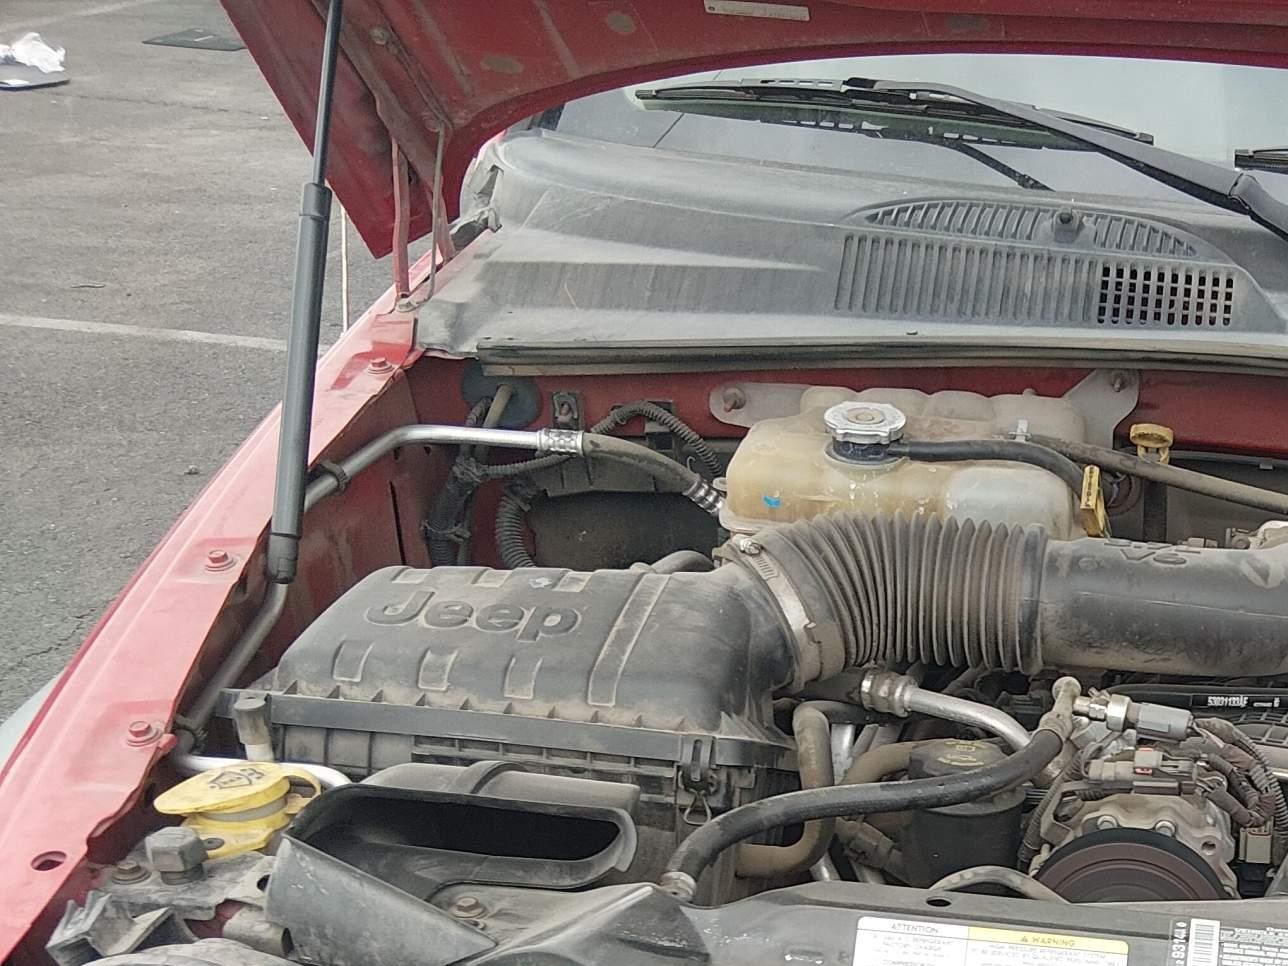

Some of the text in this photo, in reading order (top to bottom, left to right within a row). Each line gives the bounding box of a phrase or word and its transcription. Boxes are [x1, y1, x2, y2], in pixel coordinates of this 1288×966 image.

[363, 590, 583, 643] Jeep
[890, 923, 938, 934] ATTENTION
[1032, 935, 1075, 947] WARNING
